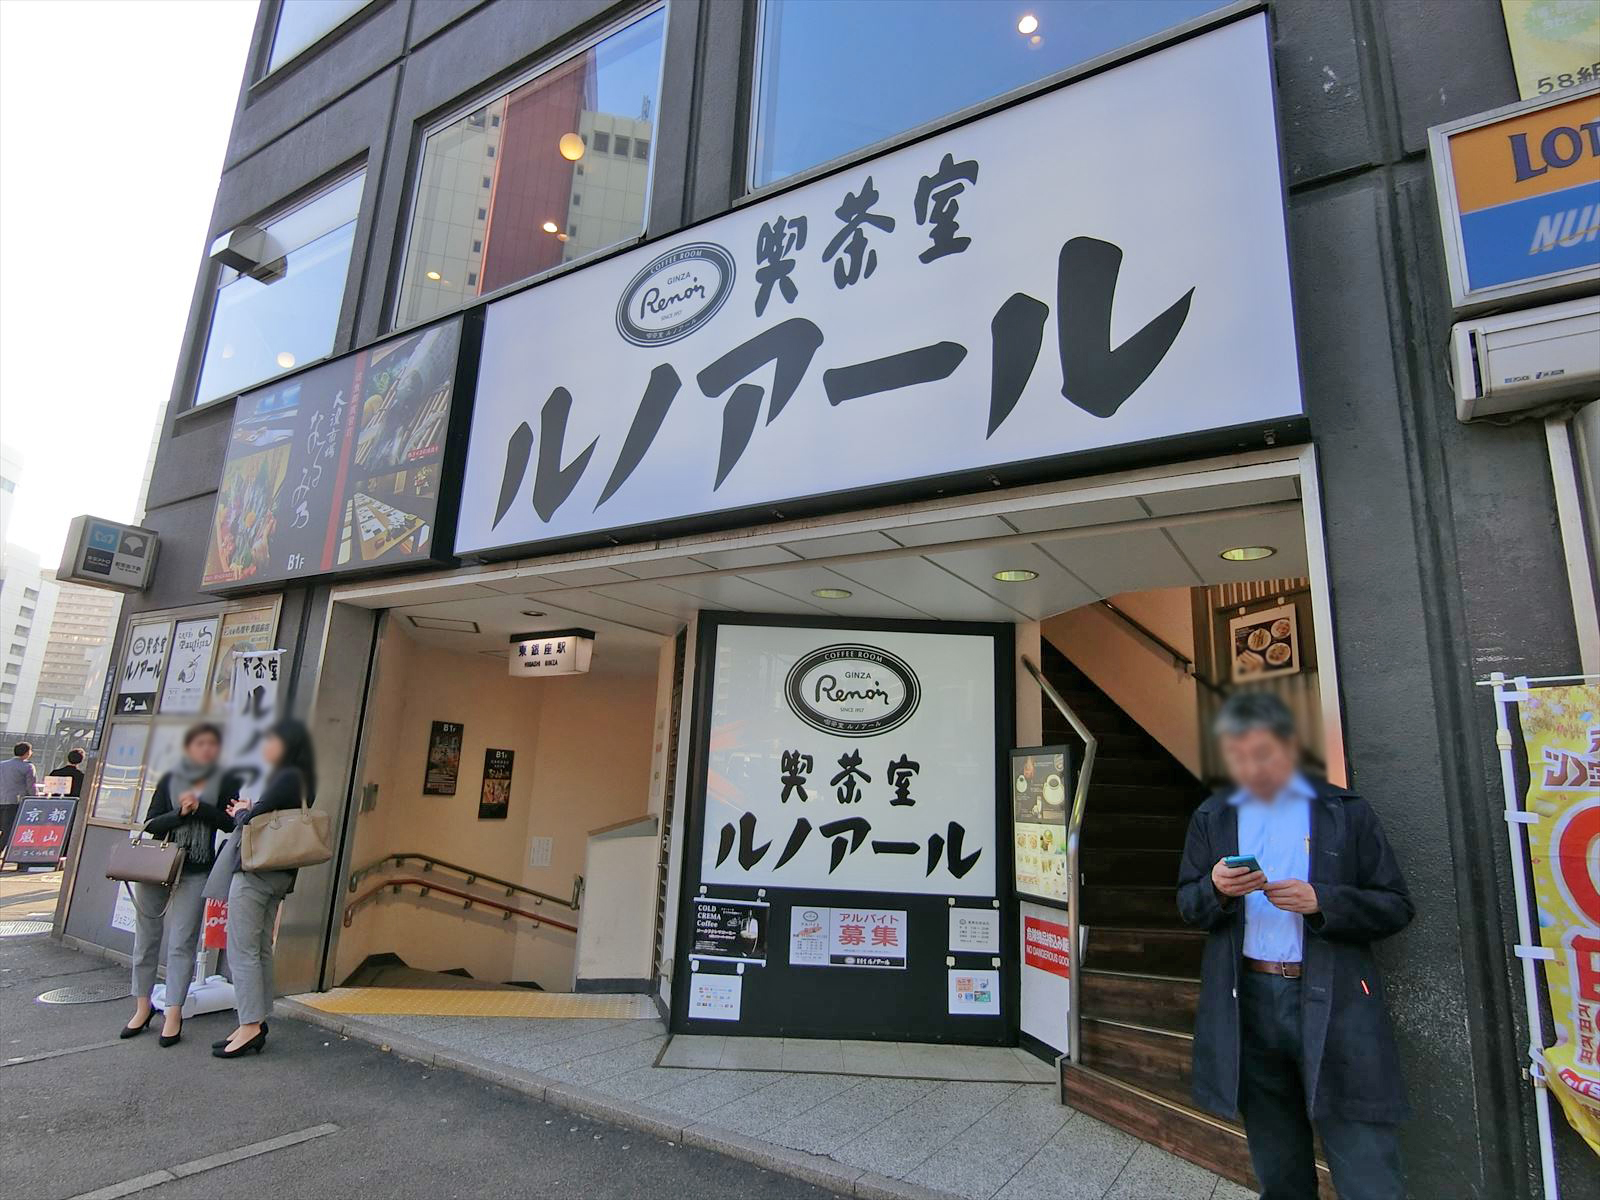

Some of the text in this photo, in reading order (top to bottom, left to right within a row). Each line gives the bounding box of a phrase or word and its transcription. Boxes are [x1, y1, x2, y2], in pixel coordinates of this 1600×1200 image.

[754, 153, 979, 317] 喫茶室
[650, 249, 703, 274] COFFEE ROOM
[667, 271, 691, 285] GINZA
[640, 276, 706, 320] Renoir
[491, 236, 1196, 532] ルノアール
[287, 552, 305, 571] B1F
[518, 641, 567, 657] 東銀座駅
[824, 650, 884, 663] COFFEE ROOM
[124, 658, 162, 682] ルノアール
[844, 671, 872, 679] GINZA
[814, 674, 889, 706] Renoir
[124, 697, 136, 712] 2F
[780, 748, 920, 807] 喫茶室
[26, 808, 68, 823] 京都
[18, 829, 59, 844] 嵐山
[714, 811, 983, 880] ルノアール
[698, 904, 717, 912] COLD
[697, 912, 721, 921] CREMA
[697, 920, 719, 928] Coffee
[840, 913, 899, 924] アルバイト
[838, 923, 899, 947] 募集
[1026, 945, 1033, 954] NO
[1033, 946, 1059, 962] DANGEROUS
